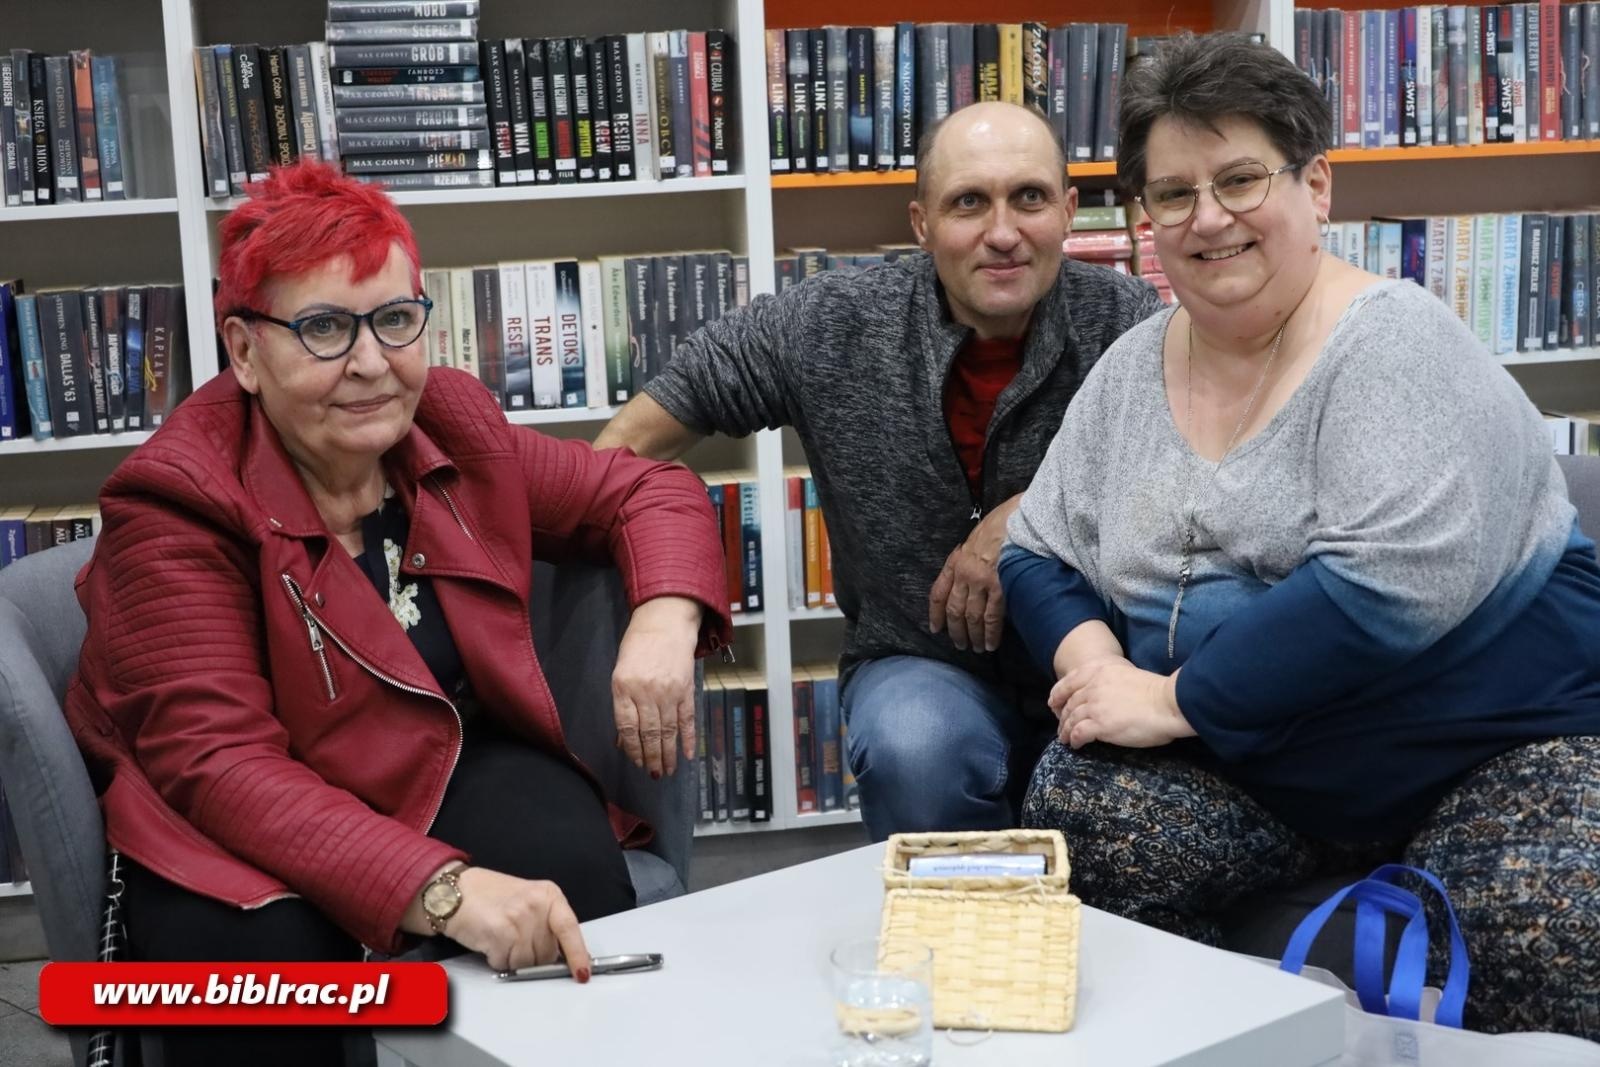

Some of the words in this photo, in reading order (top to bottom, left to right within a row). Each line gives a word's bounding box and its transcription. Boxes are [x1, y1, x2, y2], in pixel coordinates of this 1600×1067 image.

[414, 3, 447, 17] MORD
[411, 44, 445, 62] GRÓB
[1528, 9, 1539, 74] PODEJRZANY
[240, 54, 250, 89] Cleeves
[246, 61, 254, 78] Ann
[270, 54, 280, 76] Harlan
[594, 52, 602, 70] MAX
[711, 62, 723, 92] CZUBAJ
[2, 66, 13, 107] GERRITSEN
[272, 76, 282, 99] Coben
[493, 69, 502, 108] CZORNYJ
[553, 74, 566, 88] MAX
[576, 74, 586, 88] MAX
[596, 73, 604, 110] CZORNYJ
[614, 64, 624, 103] CZORNYJ
[814, 80, 826, 112] LINK
[834, 80, 844, 110] LINK
[882, 80, 891, 110] LINK
[901, 61, 911, 120] NAJGORSZY
[55, 86, 66, 128] GRISHAM
[772, 82, 784, 113] LINK
[794, 82, 806, 113] LINK
[32, 99, 45, 134] KSIĘGA
[345, 116, 365, 124] MAX
[368, 116, 407, 124] CZORNYJ
[612, 113, 631, 152] BESTIA
[634, 113, 650, 145] INNA
[348, 139, 368, 148] MAX
[370, 138, 411, 146] CZORNYJ
[496, 122, 512, 158] FATUM
[514, 122, 531, 154] WINA
[594, 120, 612, 153] KREW
[903, 122, 911, 148] DOM
[36, 144, 48, 173] IMION
[352, 159, 373, 167] MAX
[375, 156, 415, 166] CZORNYJ
[1432, 220, 1445, 262] MARTA
[1457, 216, 1470, 260] MARTA
[1481, 216, 1494, 260] MARTA
[1503, 215, 1518, 260] MARTA
[1531, 228, 1542, 265] MARIUSZ
[636, 264, 647, 279] Åke
[666, 266, 677, 281] Åke
[695, 264, 705, 280] Åke
[717, 262, 726, 278] Åke
[1530, 266, 1539, 293] ZIELKE
[54, 296, 65, 330] STEPHEN
[612, 285, 621, 328] Edwardson
[637, 280, 646, 320] Edwardson
[667, 282, 677, 322] Edwardson
[695, 280, 705, 320] Edwardson
[60, 332, 68, 350] KING
[508, 316, 524, 356] RESET
[534, 316, 553, 366] TRANS
[562, 314, 580, 366] DETOKS
[60, 353, 74, 386] DALLAS
[64, 387, 76, 402] '63
